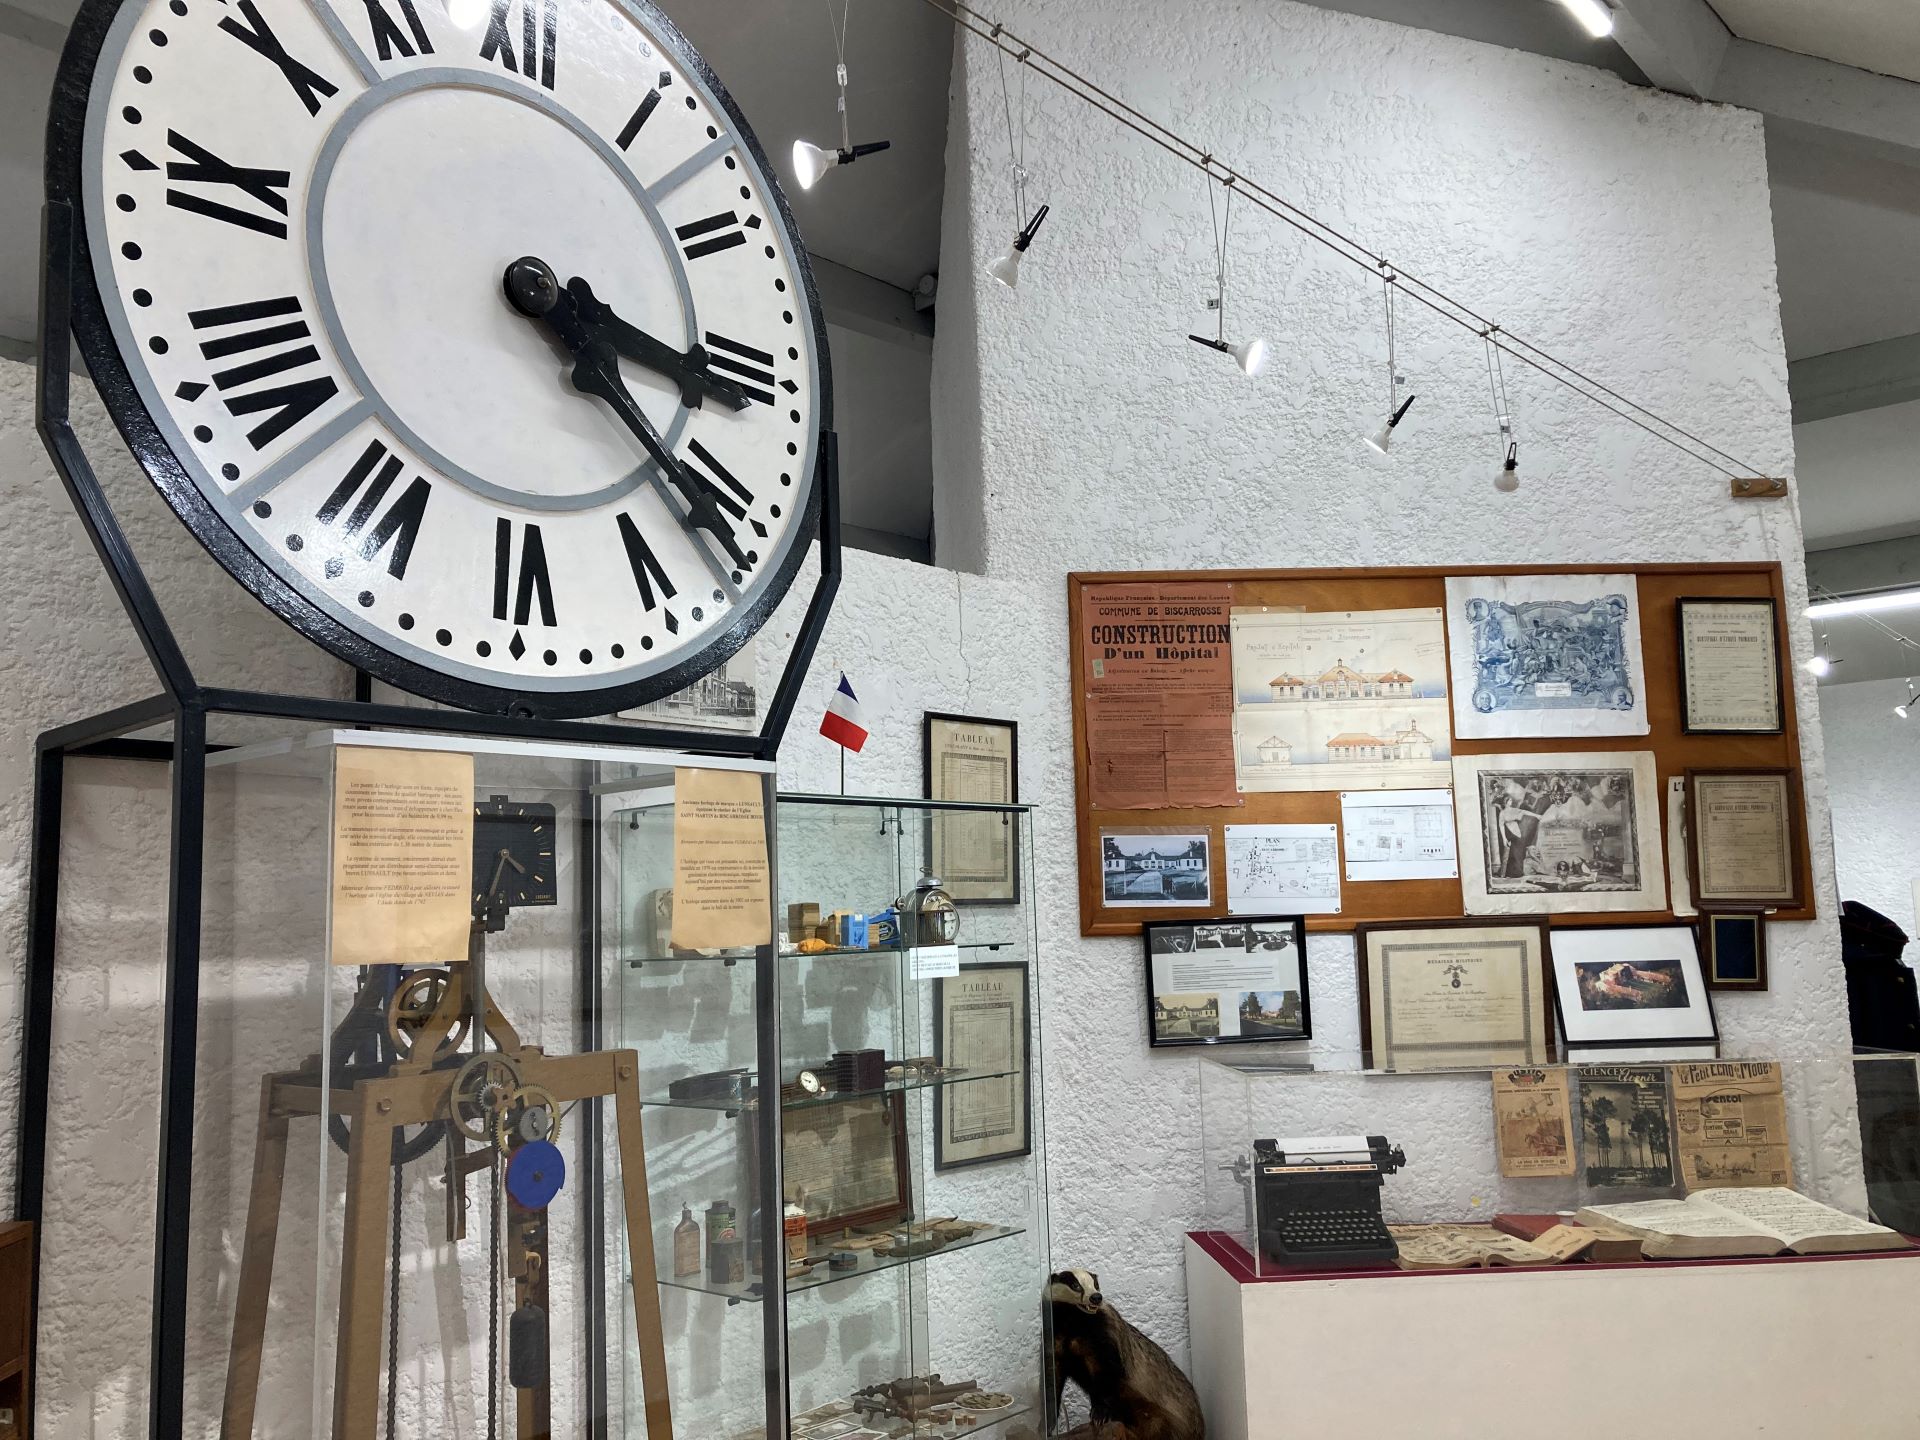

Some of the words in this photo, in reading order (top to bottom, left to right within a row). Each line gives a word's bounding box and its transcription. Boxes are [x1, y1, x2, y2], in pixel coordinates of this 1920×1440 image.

[217, 0, 339, 117] X
[615, 87, 662, 152] I
[166, 128, 290, 240] IX
[675, 210, 747, 261] II
[188, 296, 339, 452] VIII
[315, 438, 432, 581] VII
[493, 516, 557, 627] VI
[616, 511, 678, 612] V
[1091, 624, 1231, 644] CONSTRUCTION
[1099, 607, 1141, 616] COMMUNE
[1148, 607, 1158, 615] DE
[1165, 607, 1222, 616] BISCARROSSE
[1104, 647, 1145, 660] D'un
[954, 733, 995, 744] TABLEAU
